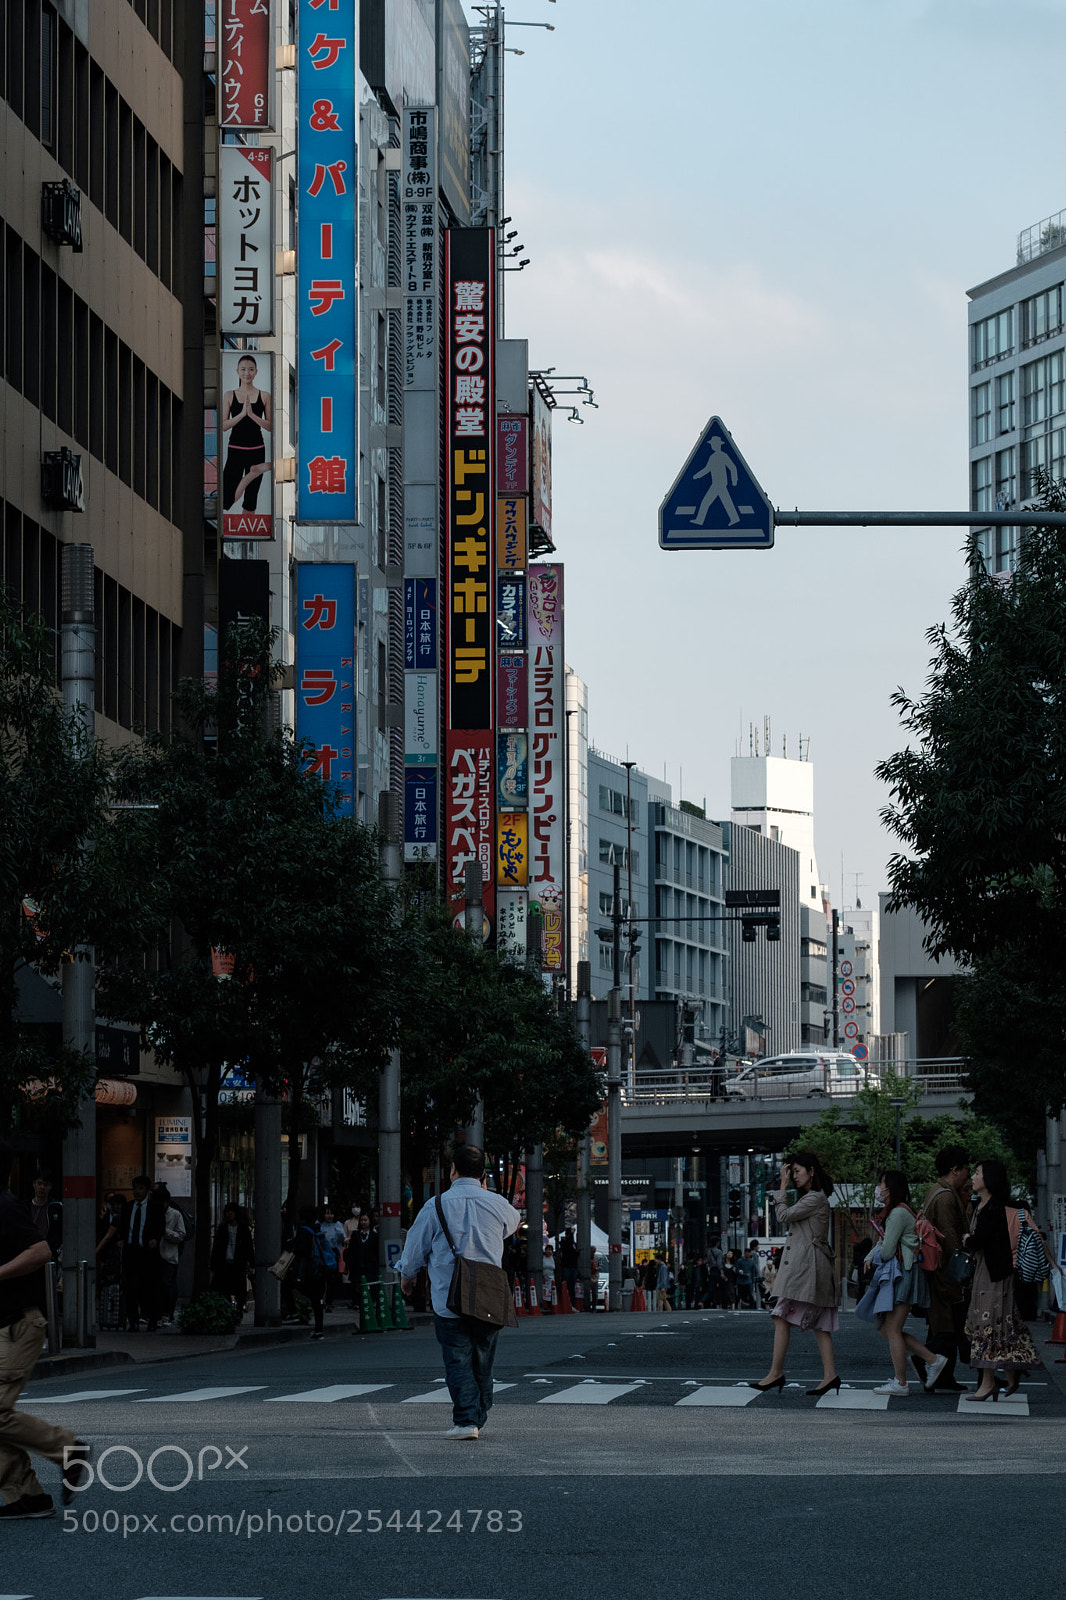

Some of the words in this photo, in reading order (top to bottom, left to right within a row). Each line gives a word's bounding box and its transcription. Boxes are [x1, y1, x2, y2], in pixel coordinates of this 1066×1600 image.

[253, 93, 265, 123] 6F
[231, 175, 261, 325] ホットヨガ
[454, 280, 486, 437] 驚安の殿堂
[500, 421, 522, 432] 麻雀
[504, 434, 517, 481] ダンディ
[227, 517, 268, 533] LAVA
[504, 500, 522, 567] タウンハウジング
[419, 609, 432, 655] 日本旅行
[500, 656, 524, 668] 麻雀
[412, 675, 428, 743] Hanayume
[416, 754, 427, 763] 3F
[516, 783, 527, 793] 3F
[414, 787, 427, 838] 日本旅行
[502, 814, 522, 826] 2F
[532, 732, 558, 884] グリンピース
[387, 1244, 401, 1261] P
